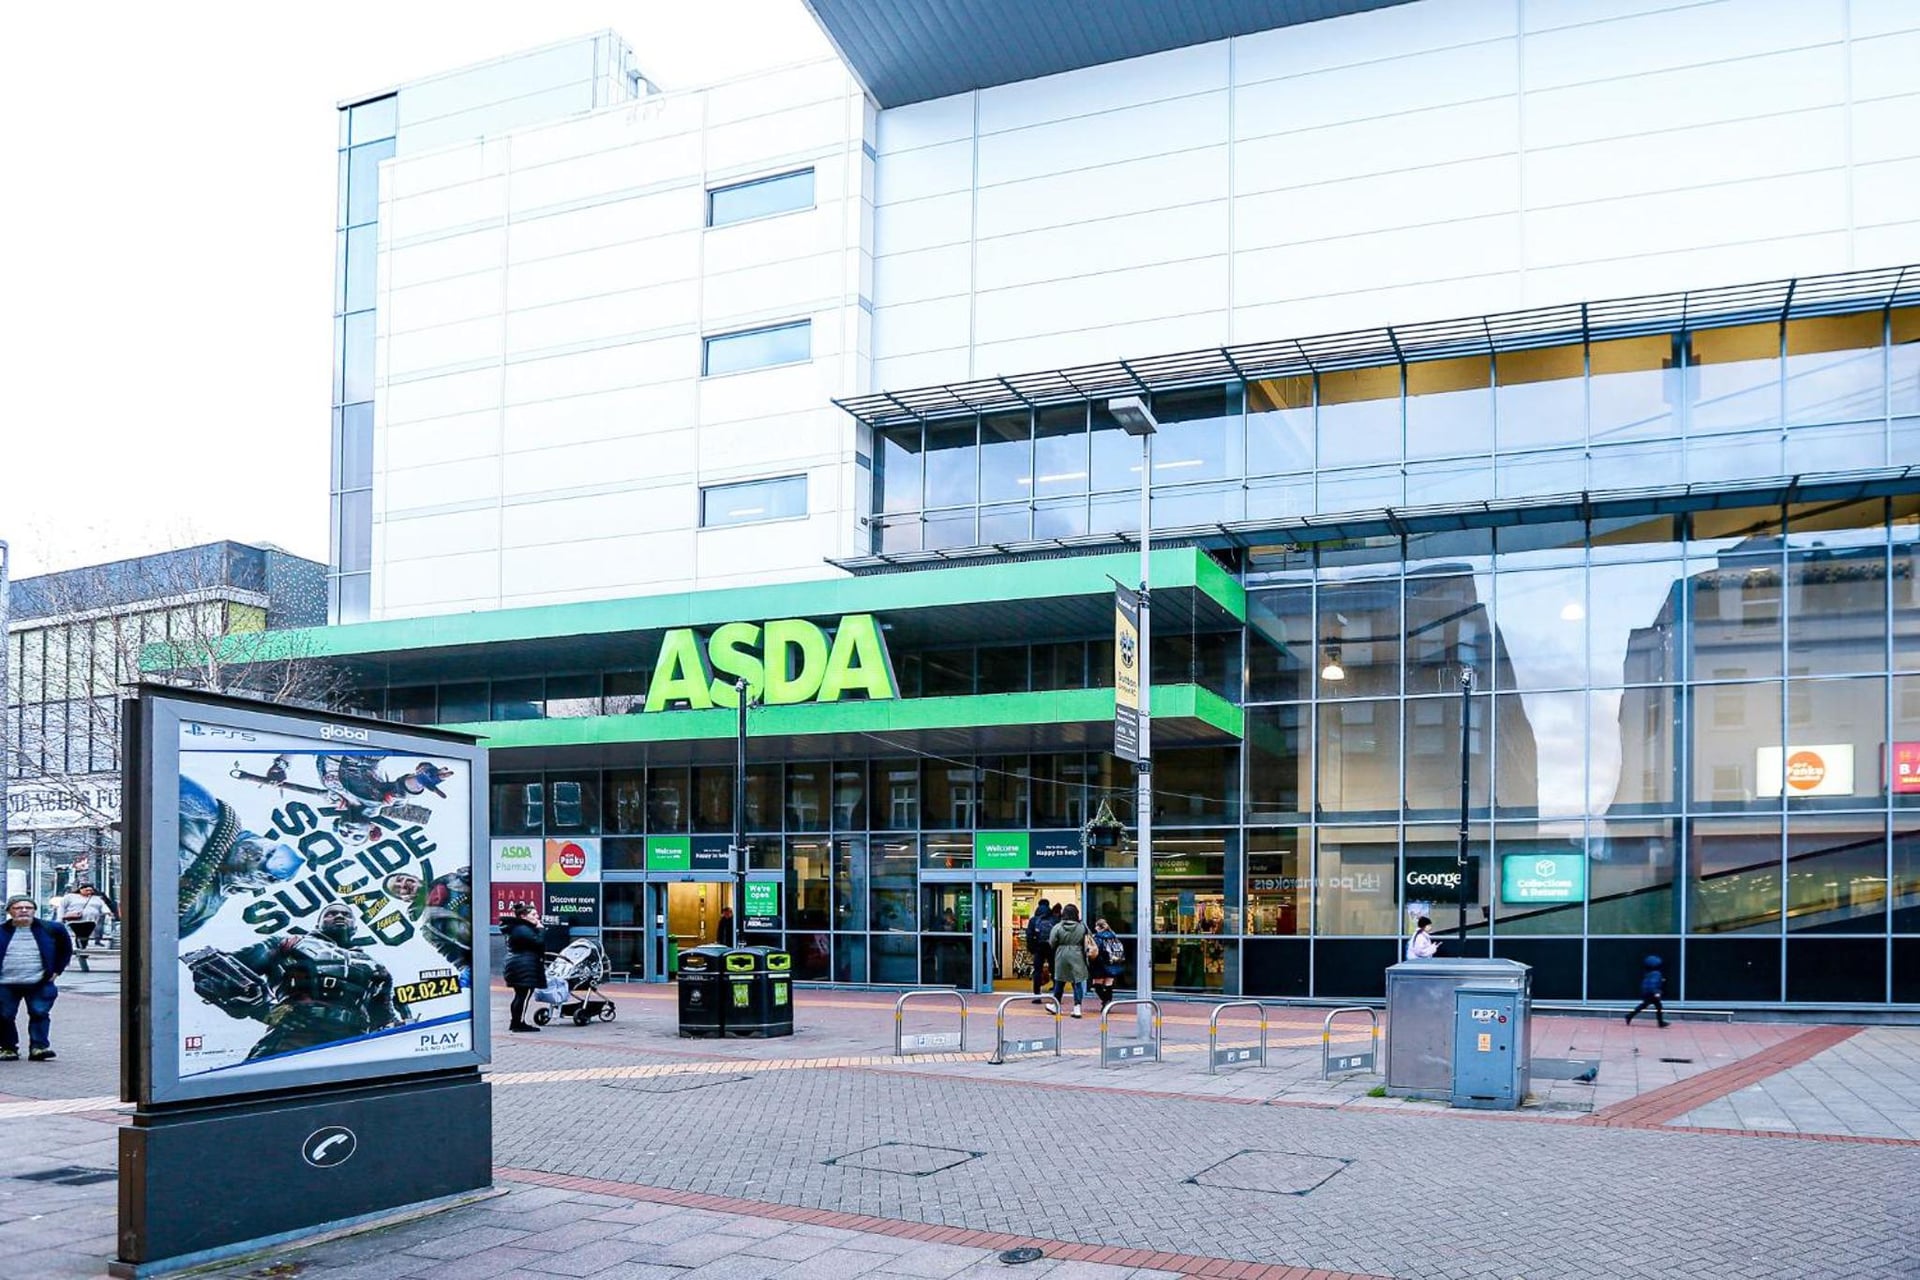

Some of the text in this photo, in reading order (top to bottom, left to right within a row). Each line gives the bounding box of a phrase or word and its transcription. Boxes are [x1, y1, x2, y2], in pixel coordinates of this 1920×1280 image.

[644, 613, 898, 712] ASDA
[210, 728, 257, 742] PS5
[319, 724, 369, 741] global
[501, 846, 532, 858] ASDA
[985, 844, 1019, 852] Welcome
[496, 862, 537, 872] Pharmacy
[560, 856, 585, 866] Panku
[242, 825, 437, 935] SUICIDE
[1406, 871, 1462, 889] George
[1517, 879, 1572, 888] Collections
[497, 889, 535, 899] HAJI
[550, 895, 596, 904] Discover more
[397, 977, 459, 1004] 02.02.24
[420, 1032, 459, 1046] PLAY
